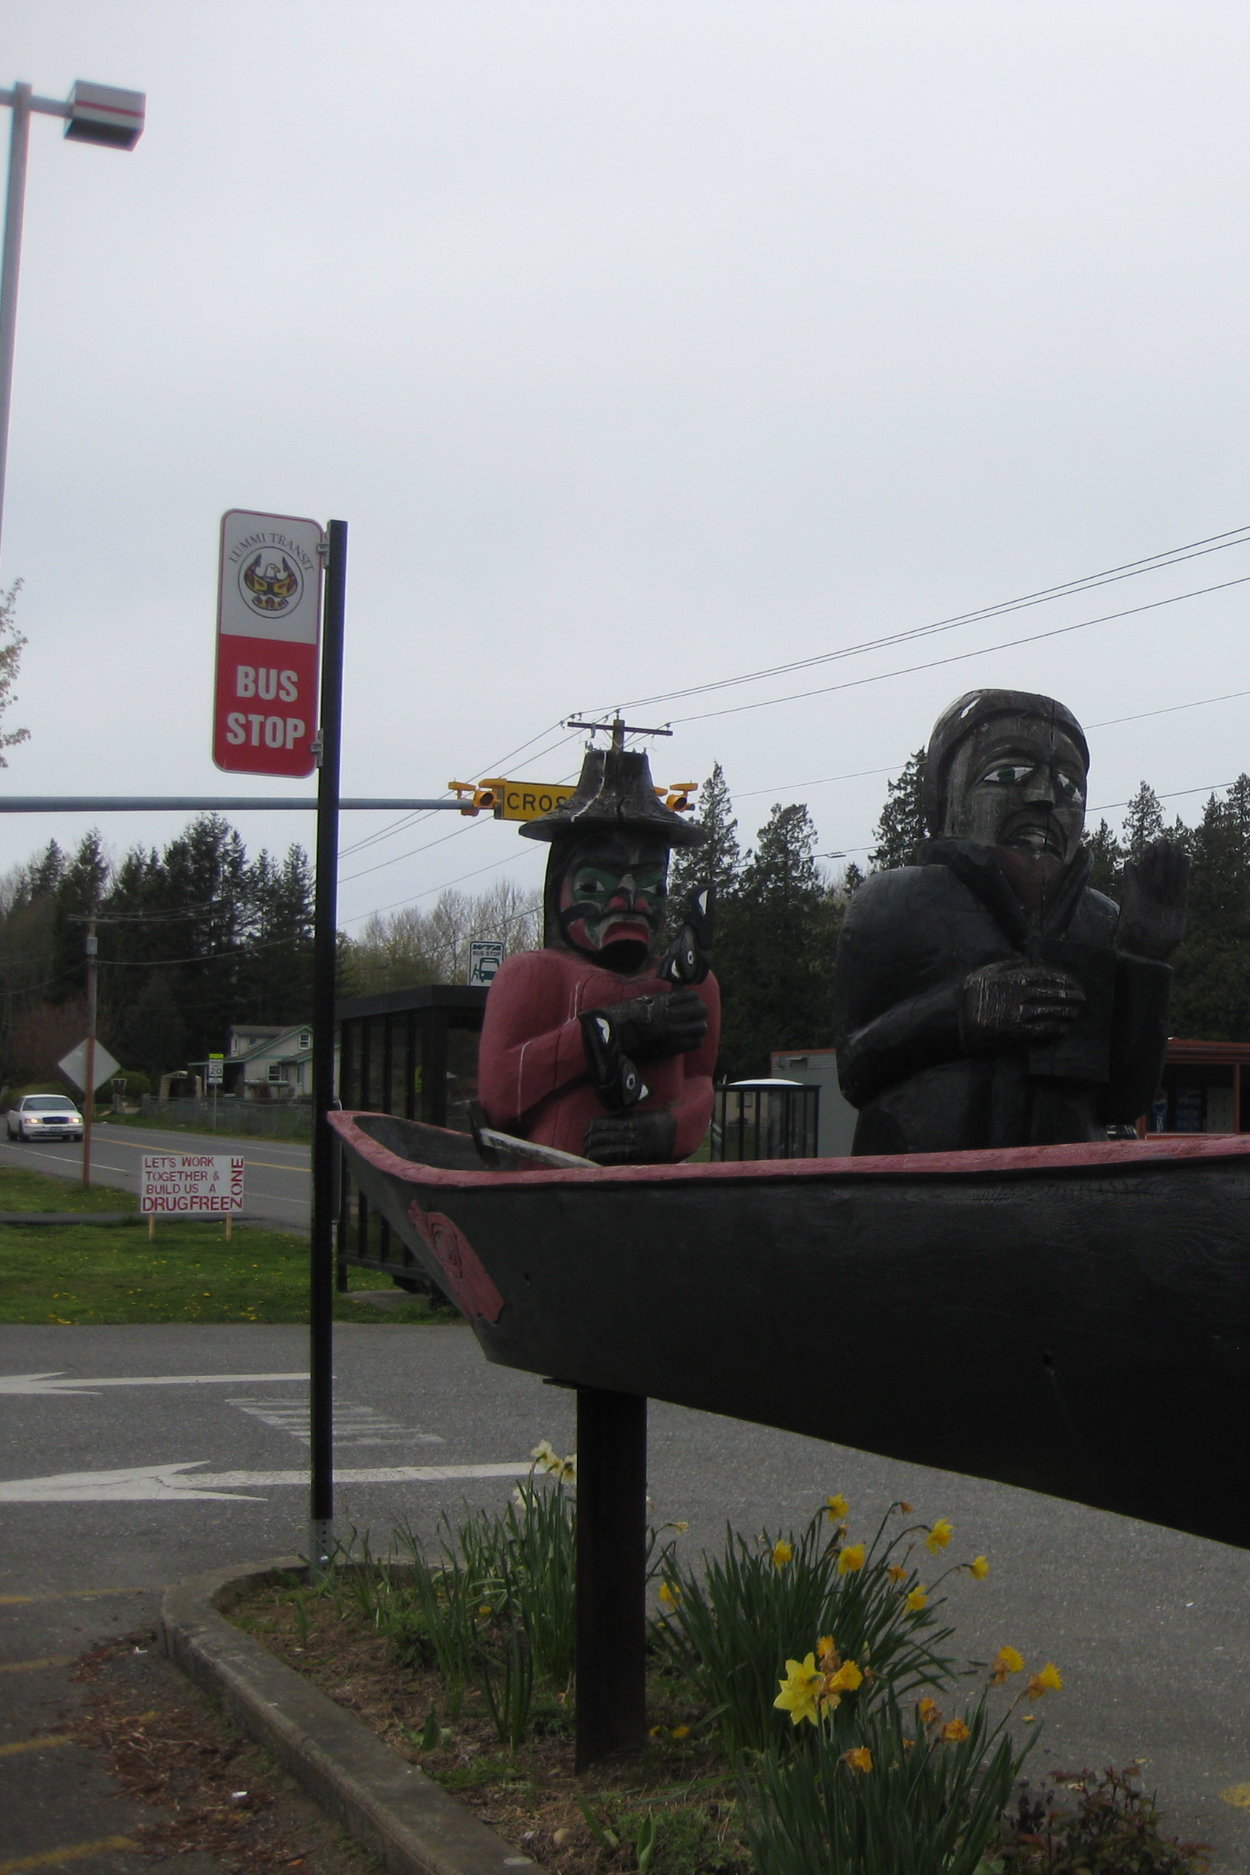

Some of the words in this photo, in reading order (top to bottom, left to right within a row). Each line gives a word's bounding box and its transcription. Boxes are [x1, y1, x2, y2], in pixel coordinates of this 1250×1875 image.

[228, 532, 267, 564] LUMMI
[269, 532, 315, 571] TRANSIT
[236, 665, 299, 702] BUS
[226, 712, 306, 750] STOP
[144, 1158, 176, 1168] LET'S
[182, 1157, 215, 1167] WORK
[145, 1171, 208, 1181] TOGETHER
[212, 1171, 220, 1180] &
[146, 1184, 181, 1195] BUILD
[184, 1183, 199, 1194] US
[209, 1184, 217, 1193] A
[230, 1158, 244, 1209] ZONE
